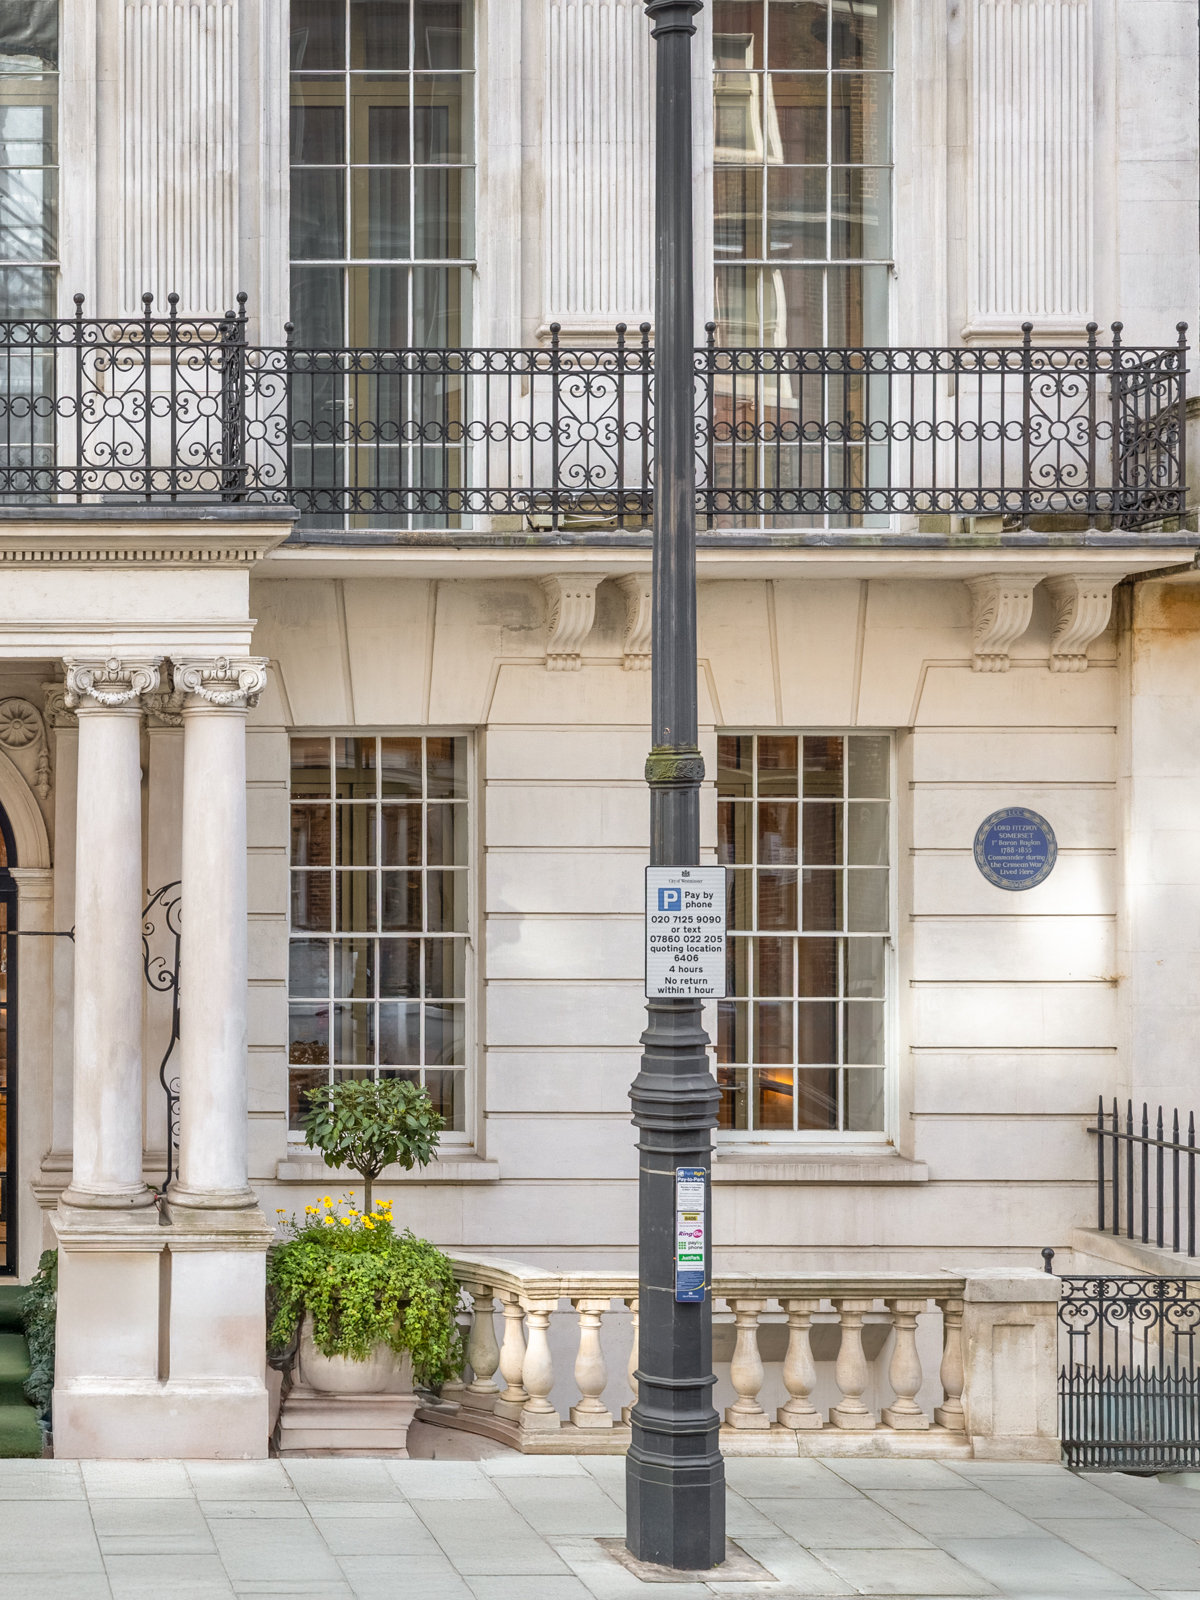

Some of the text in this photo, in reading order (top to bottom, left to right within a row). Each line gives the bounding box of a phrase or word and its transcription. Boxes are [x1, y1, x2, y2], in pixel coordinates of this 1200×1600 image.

[664, 890, 678, 909] P
[685, 891, 714, 900] Pay by
[685, 901, 712, 909] phone
[650, 945, 684, 954] quoting
